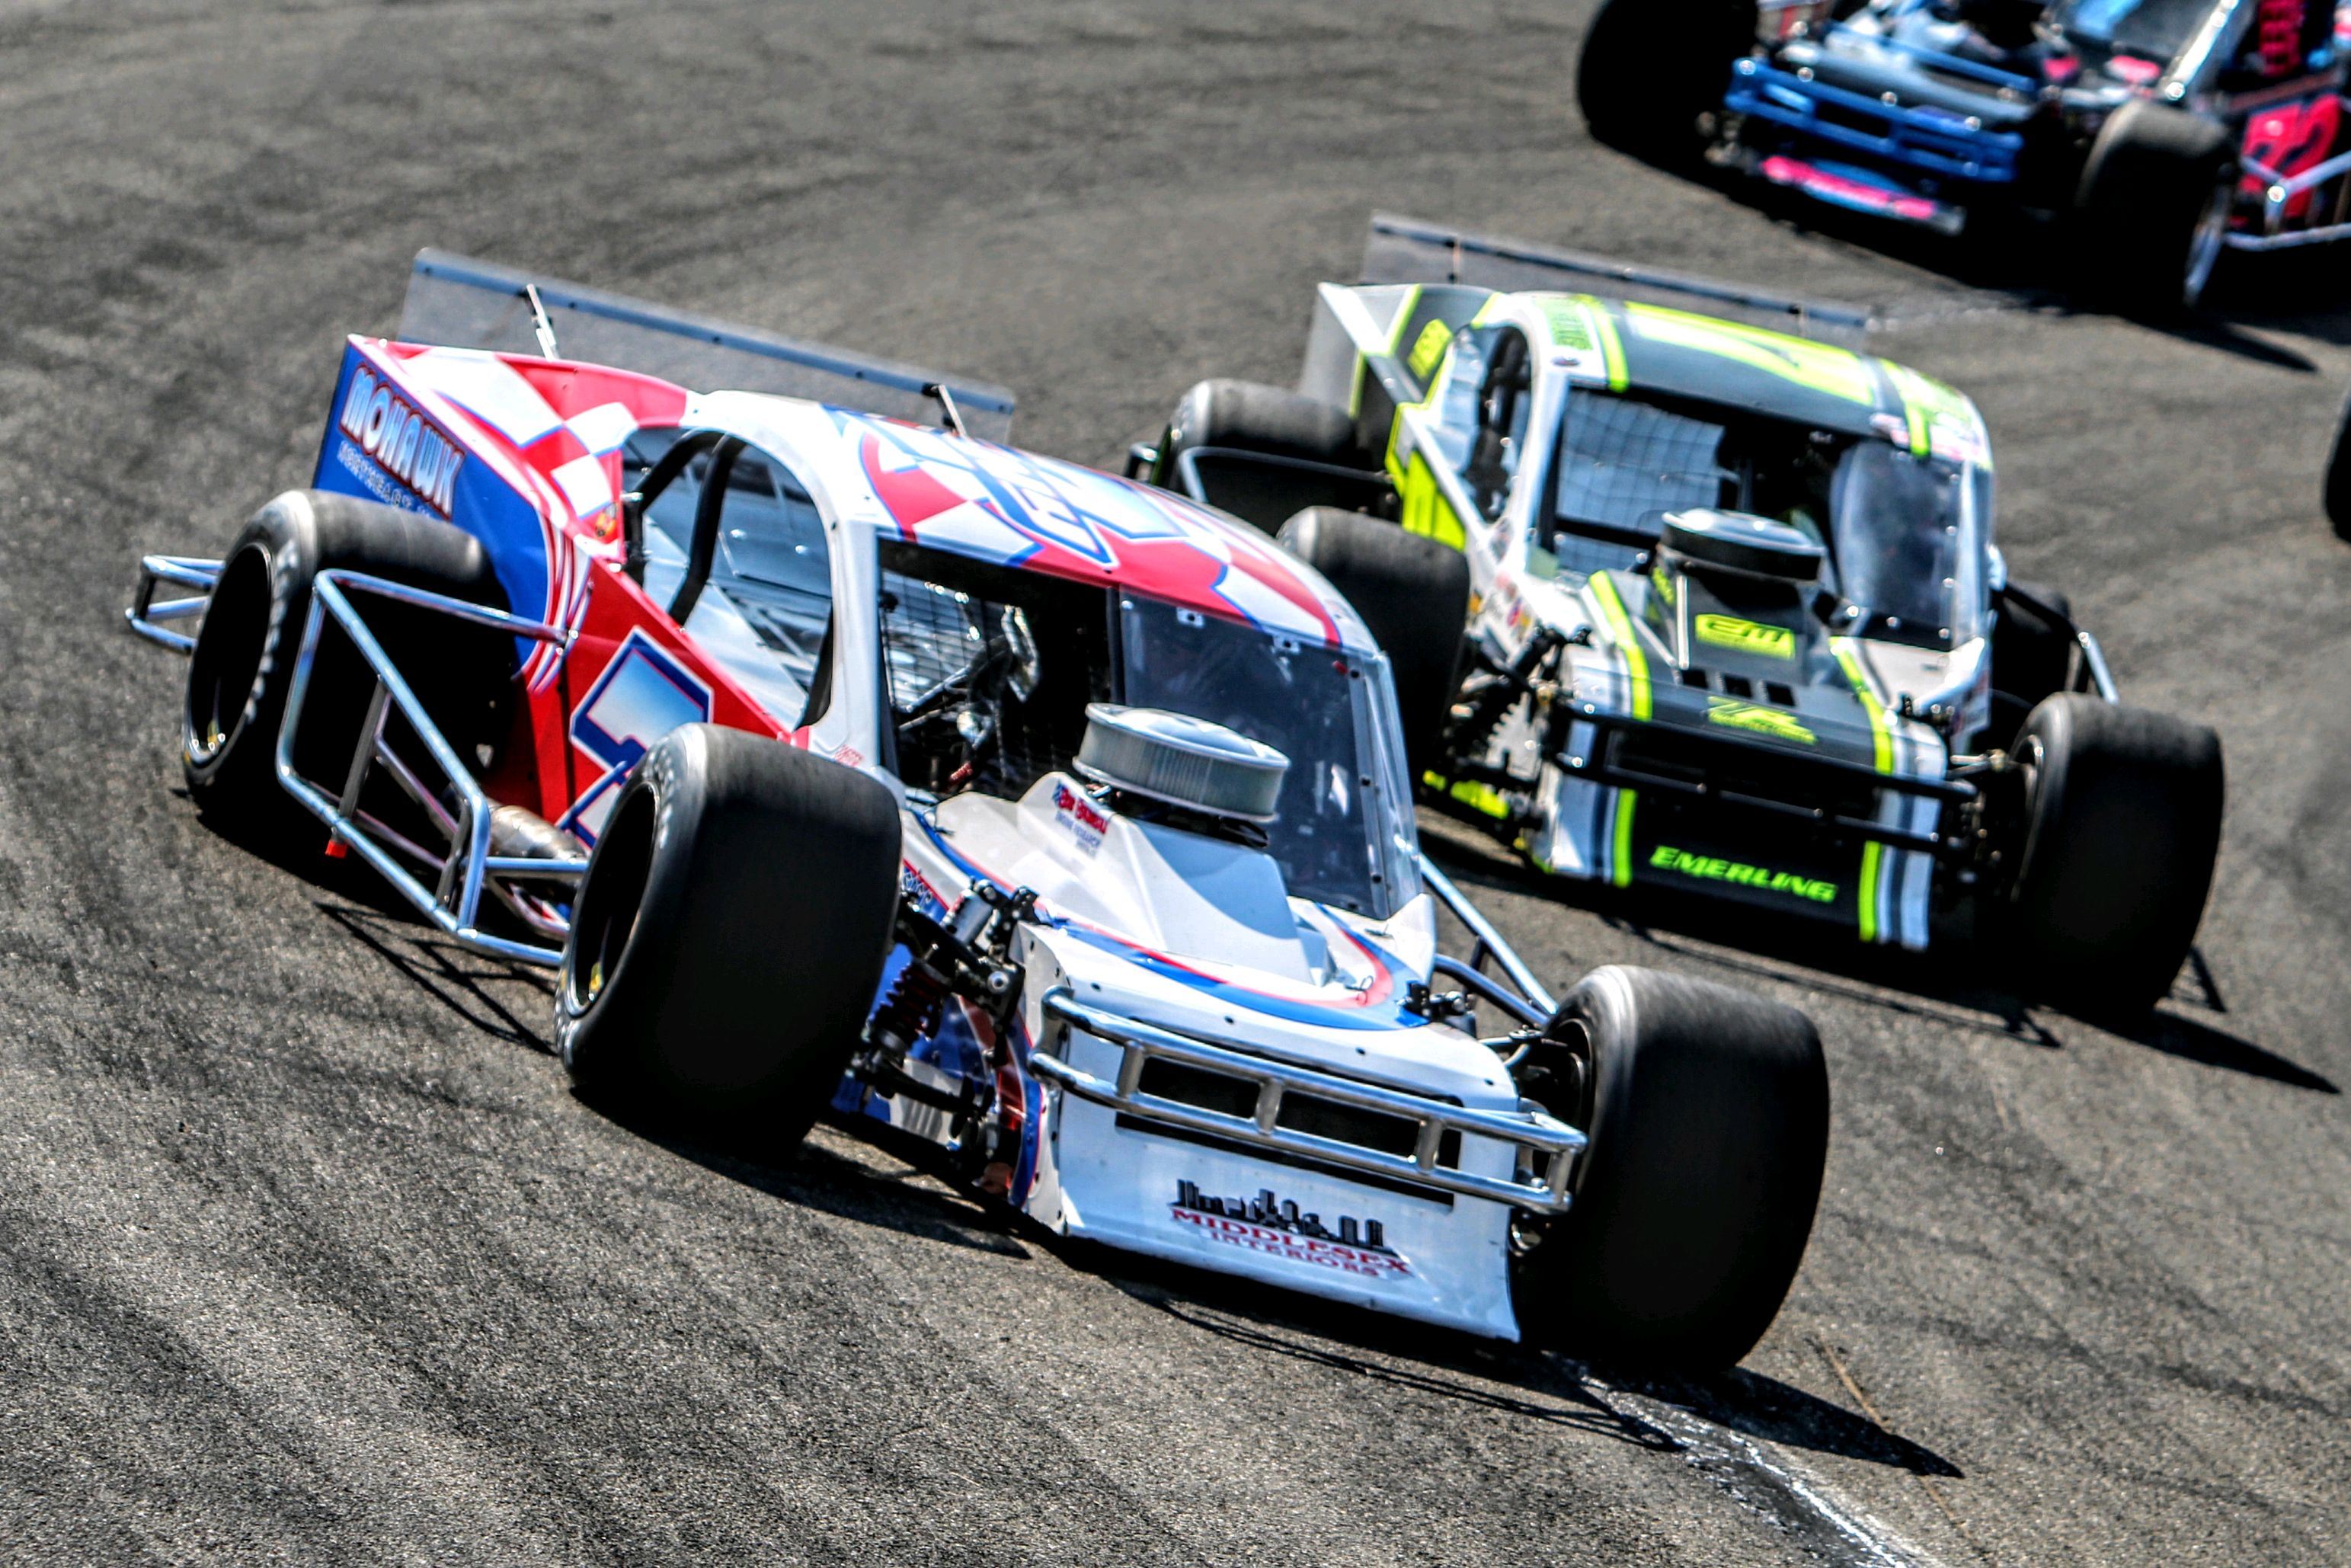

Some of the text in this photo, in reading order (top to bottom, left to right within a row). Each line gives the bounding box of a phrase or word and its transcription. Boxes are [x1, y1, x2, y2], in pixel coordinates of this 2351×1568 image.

[339, 363, 465, 522] MOHAWK
[1649, 844, 1839, 904] EMERLING
[1172, 1208, 1412, 1276] MIDDLESEX
[1211, 1231, 1379, 1278] INTERIORS
